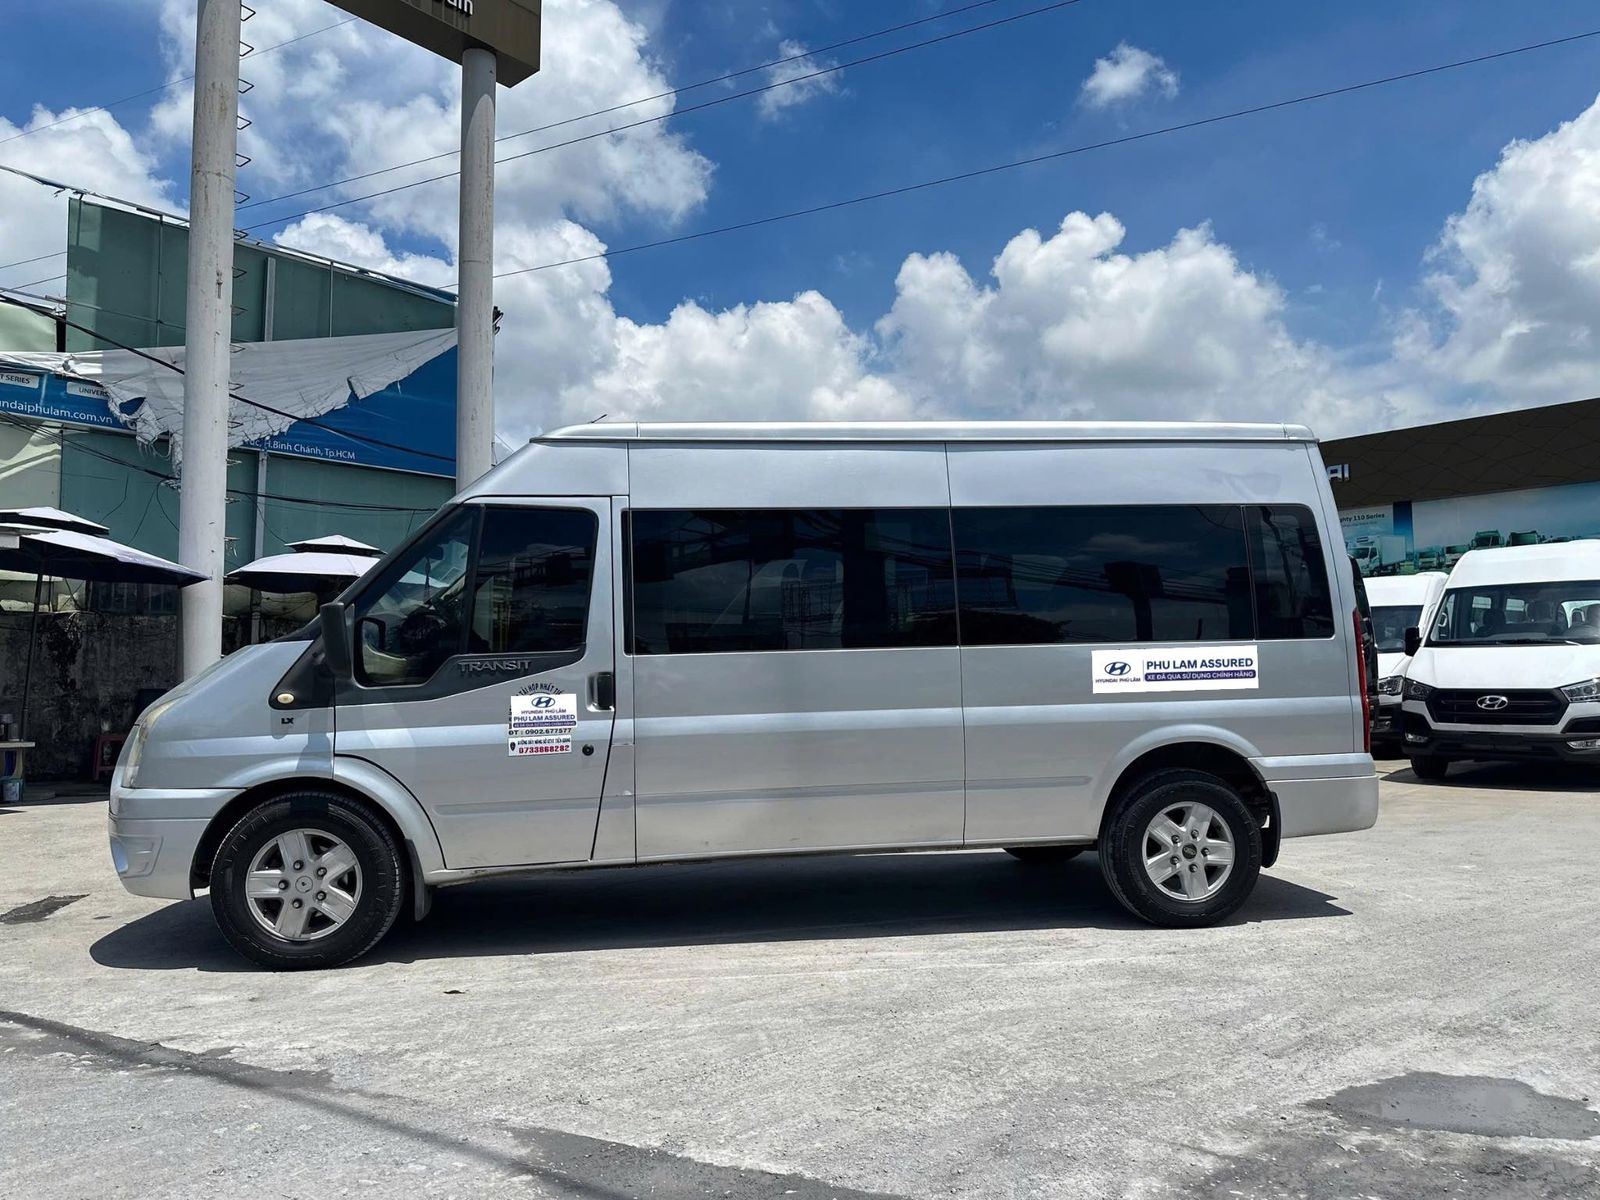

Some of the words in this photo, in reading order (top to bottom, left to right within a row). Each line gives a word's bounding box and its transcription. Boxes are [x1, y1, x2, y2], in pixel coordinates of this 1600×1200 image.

[5, 374, 31, 385] SERIES
[324, 447, 356, 460] Tp.HCM
[1366, 512, 1385, 520] Series
[457, 659, 532, 672] TRANSIT
[1146, 660, 1170, 670] PHU
[1173, 659, 1198, 669] LAM
[1200, 657, 1254, 668] ASSURED
[1167, 673, 1182, 681] QUA
[281, 717, 295, 725] LX
